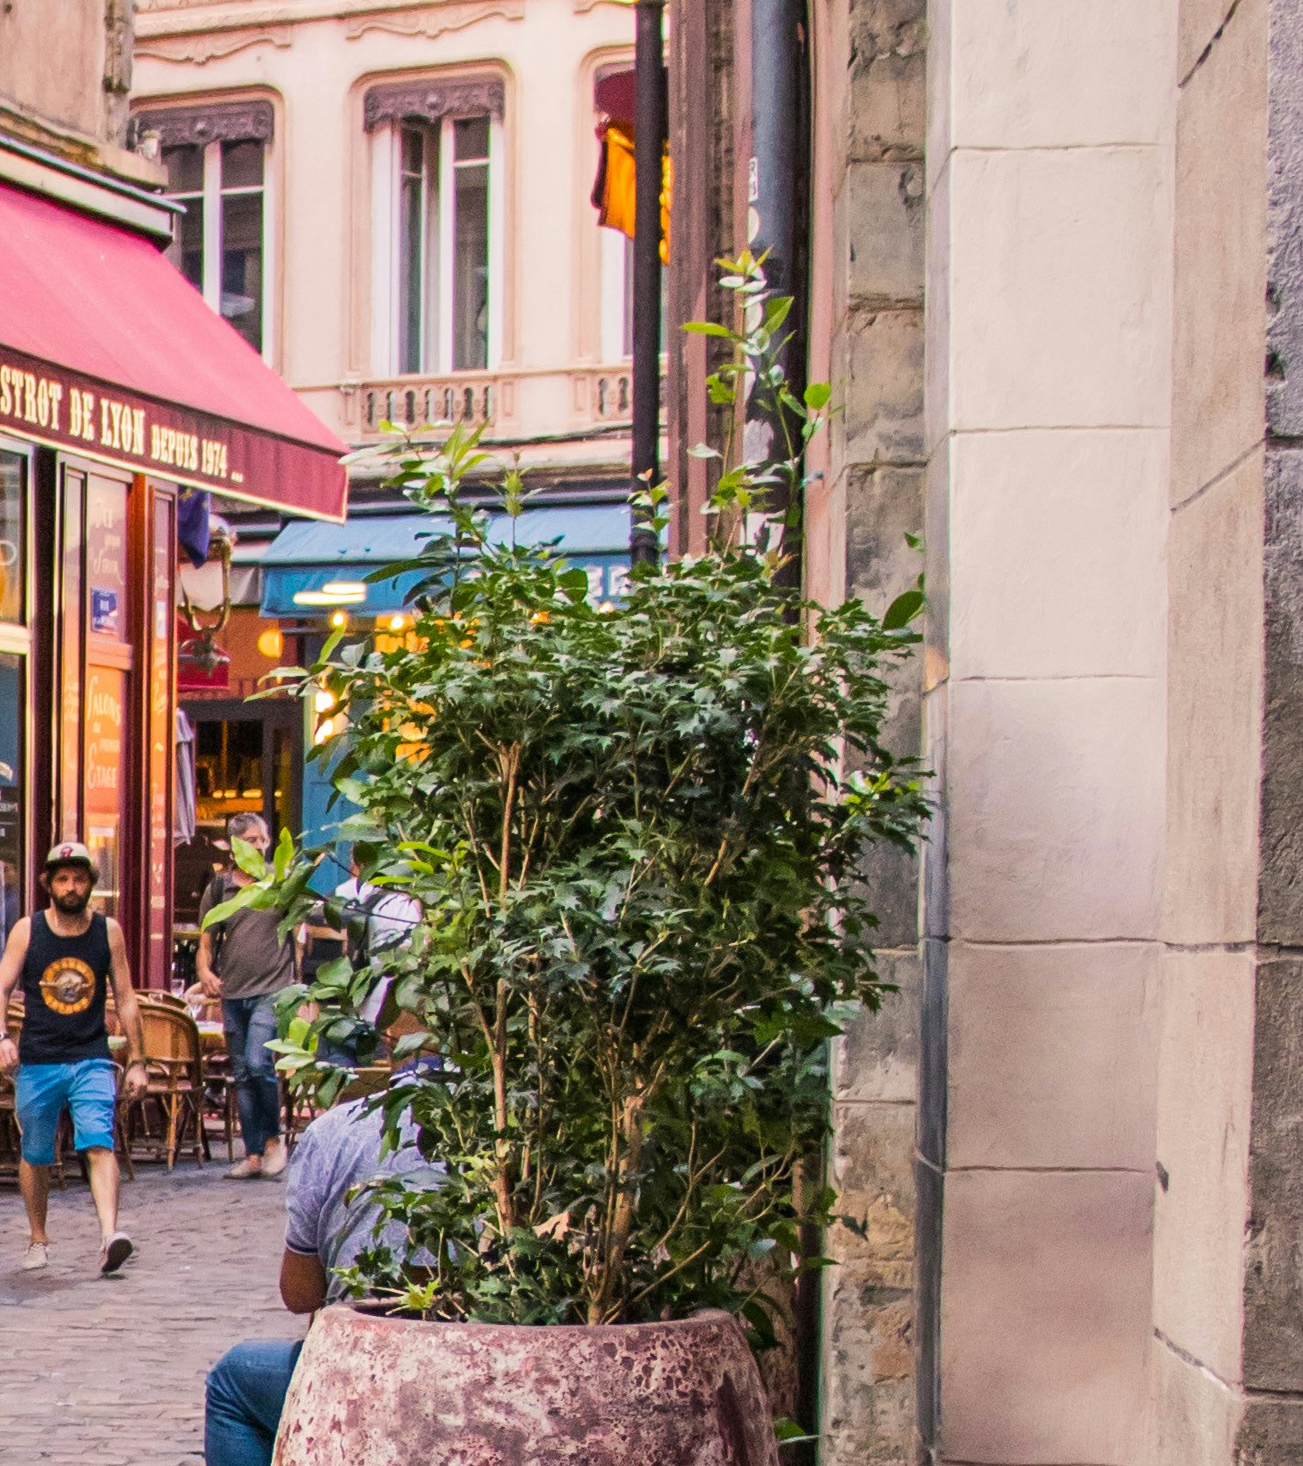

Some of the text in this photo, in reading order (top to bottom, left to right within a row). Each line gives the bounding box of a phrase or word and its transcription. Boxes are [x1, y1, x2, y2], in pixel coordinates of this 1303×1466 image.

[70, 387, 95, 441] DE
[100, 398, 146, 456] LYON
[151, 424, 199, 472] DEPUIS
[201, 438, 228, 480] 1974
